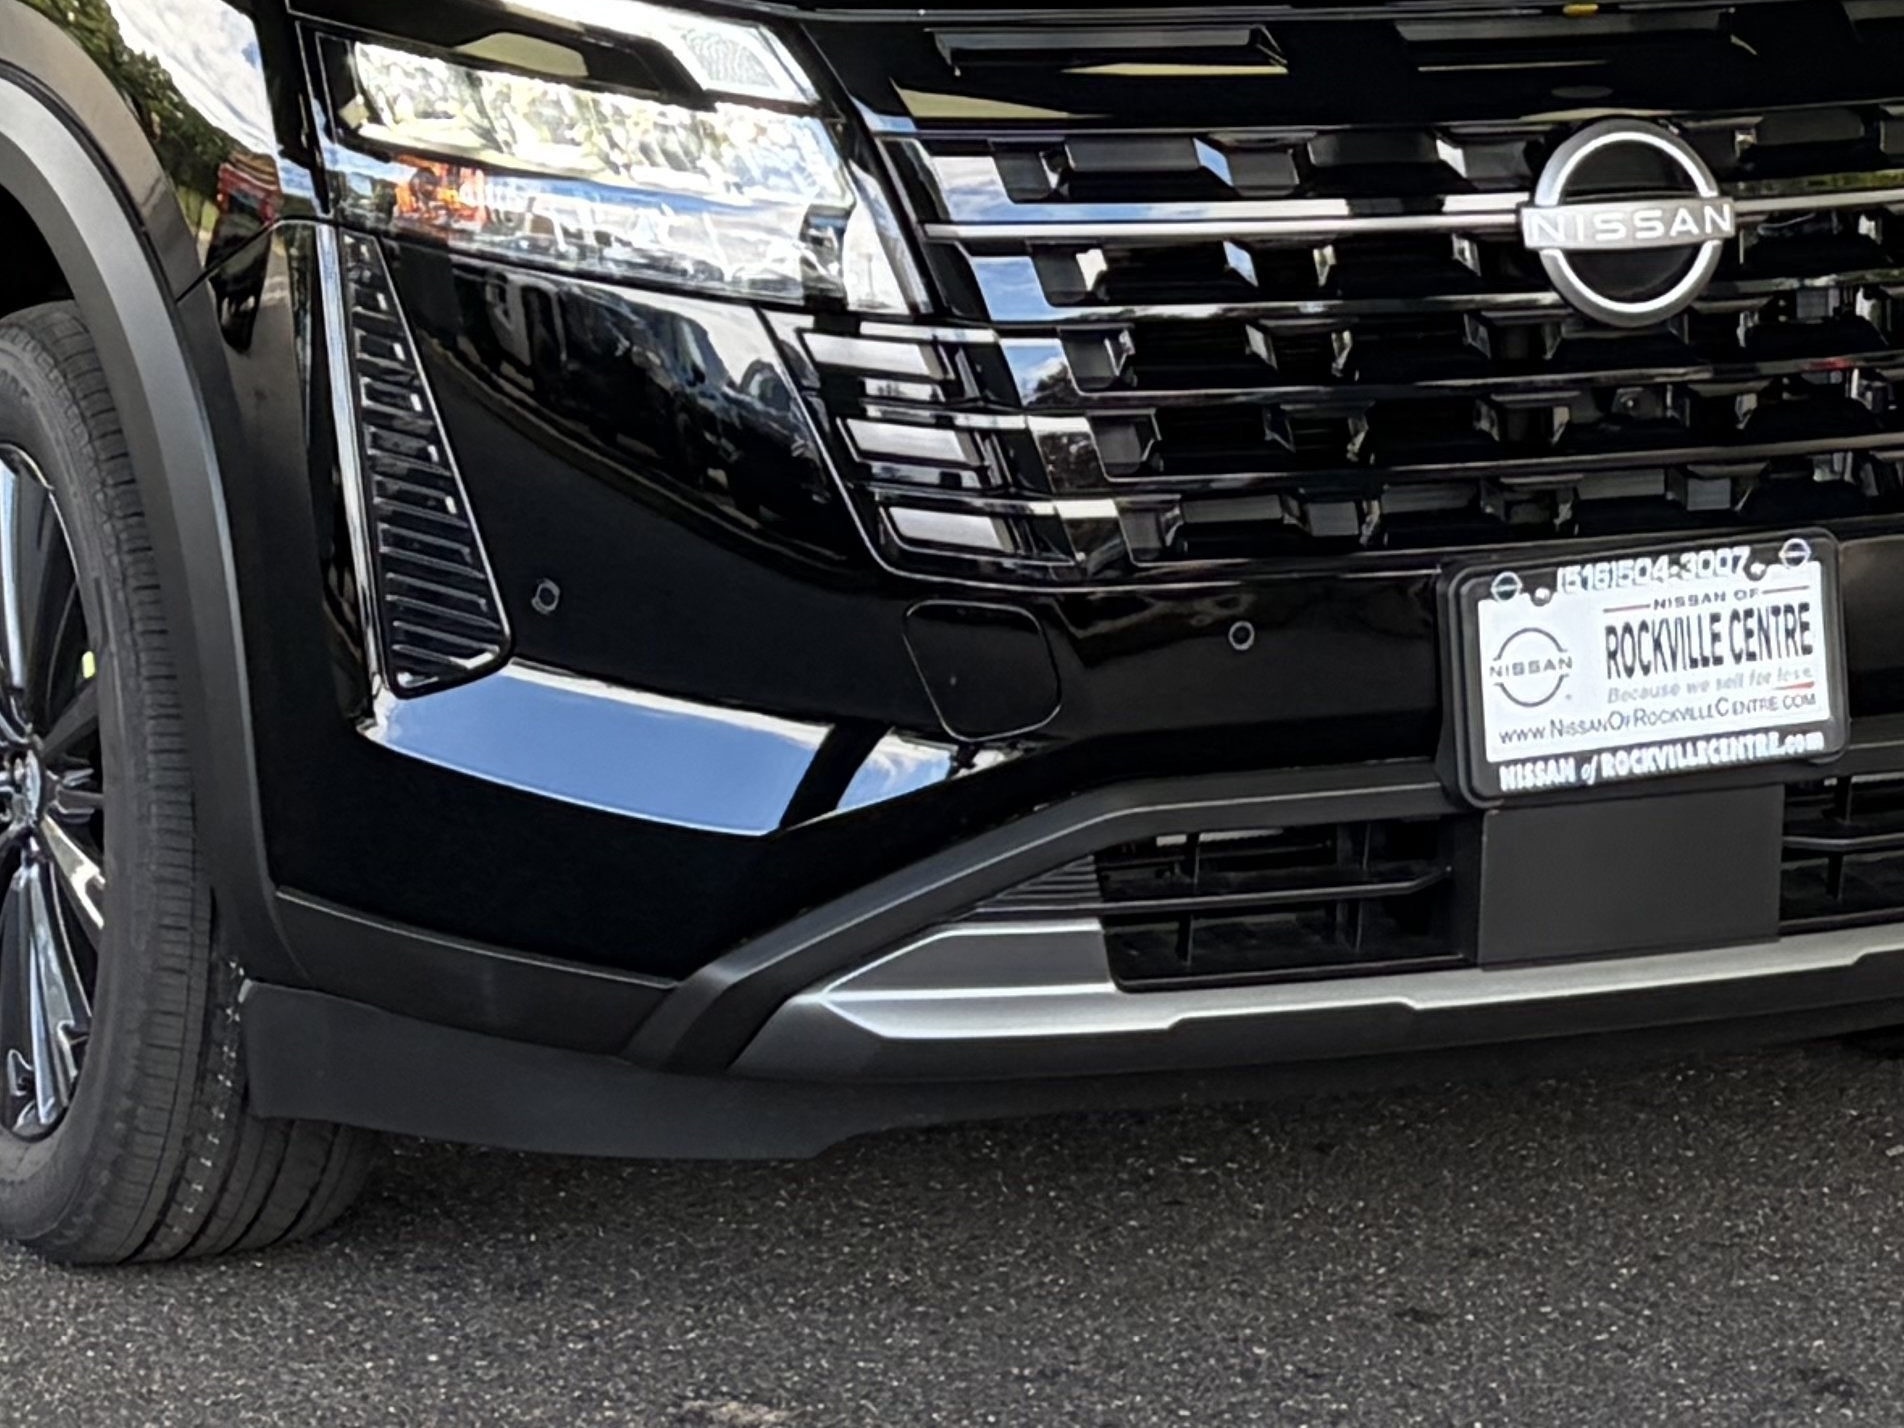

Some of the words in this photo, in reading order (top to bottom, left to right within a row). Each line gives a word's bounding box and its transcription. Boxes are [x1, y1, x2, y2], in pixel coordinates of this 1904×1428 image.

[1530, 202, 1733, 243] NISSAN
[1653, 591, 1727, 610] NISSAN
[1733, 587, 1761, 602] OF
[1605, 612, 1724, 680] ROCKVILLE
[1729, 602, 1814, 665] CENTRE
[1489, 655, 1573, 678] NISSAN
[1499, 756, 1576, 792] NISSAN
